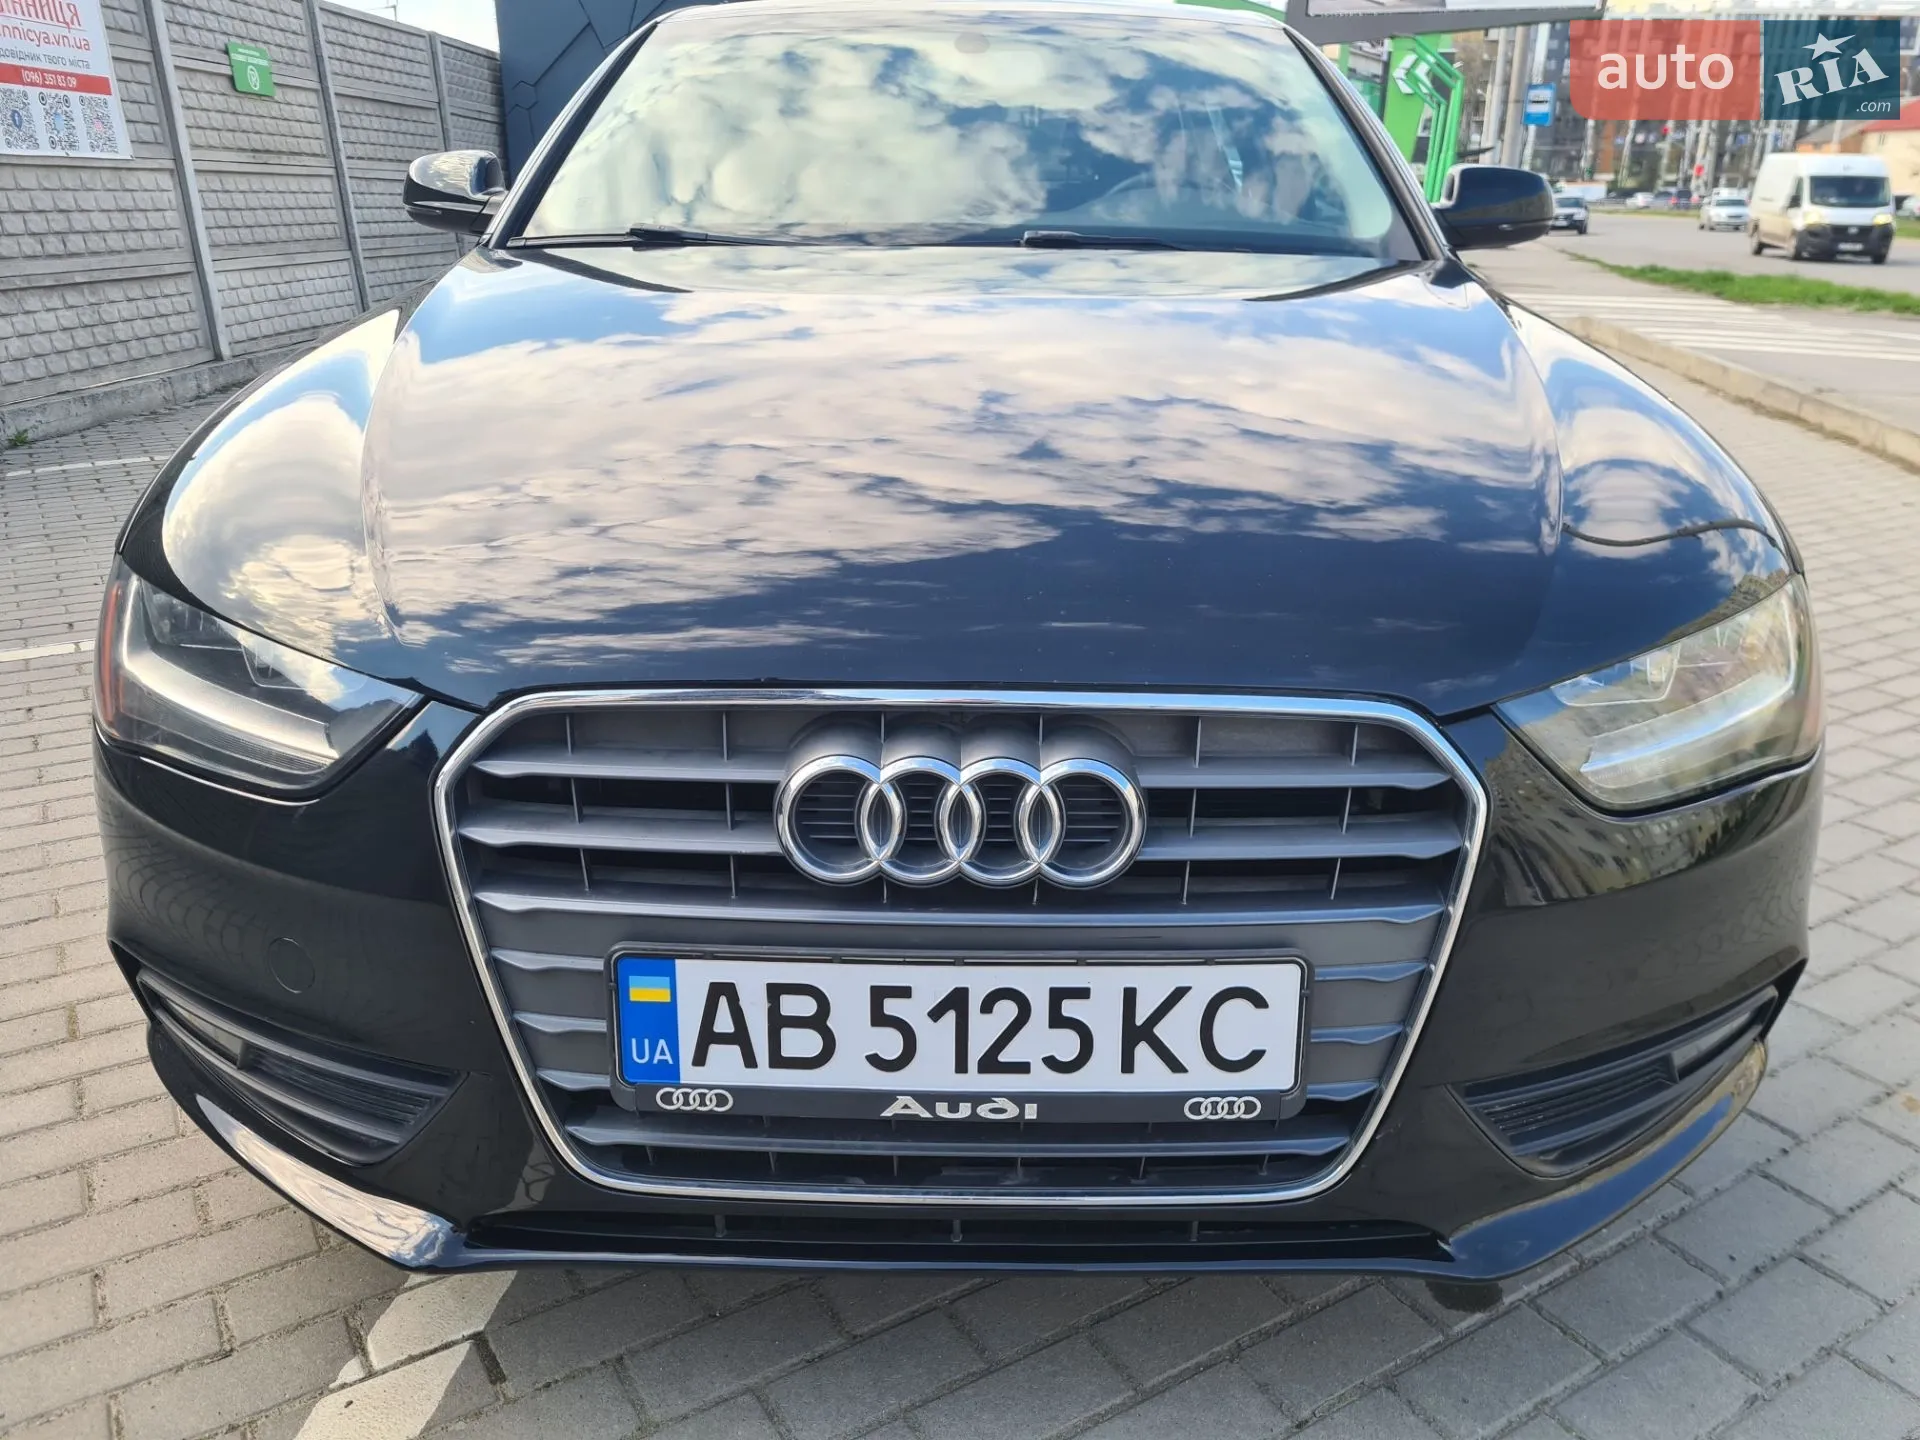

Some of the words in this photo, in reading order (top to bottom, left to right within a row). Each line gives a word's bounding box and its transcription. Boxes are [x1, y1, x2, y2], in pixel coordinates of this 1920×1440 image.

[0, 22, 91, 51] nnicya.vn.ua
[42, 53, 67, 66] твого
[691, 981, 837, 1071] AB
[864, 985, 1095, 1075] 5125
[1119, 985, 1270, 1075] KC
[631, 1038, 674, 1065] UA
[880, 1095, 1037, 1120] Audi
